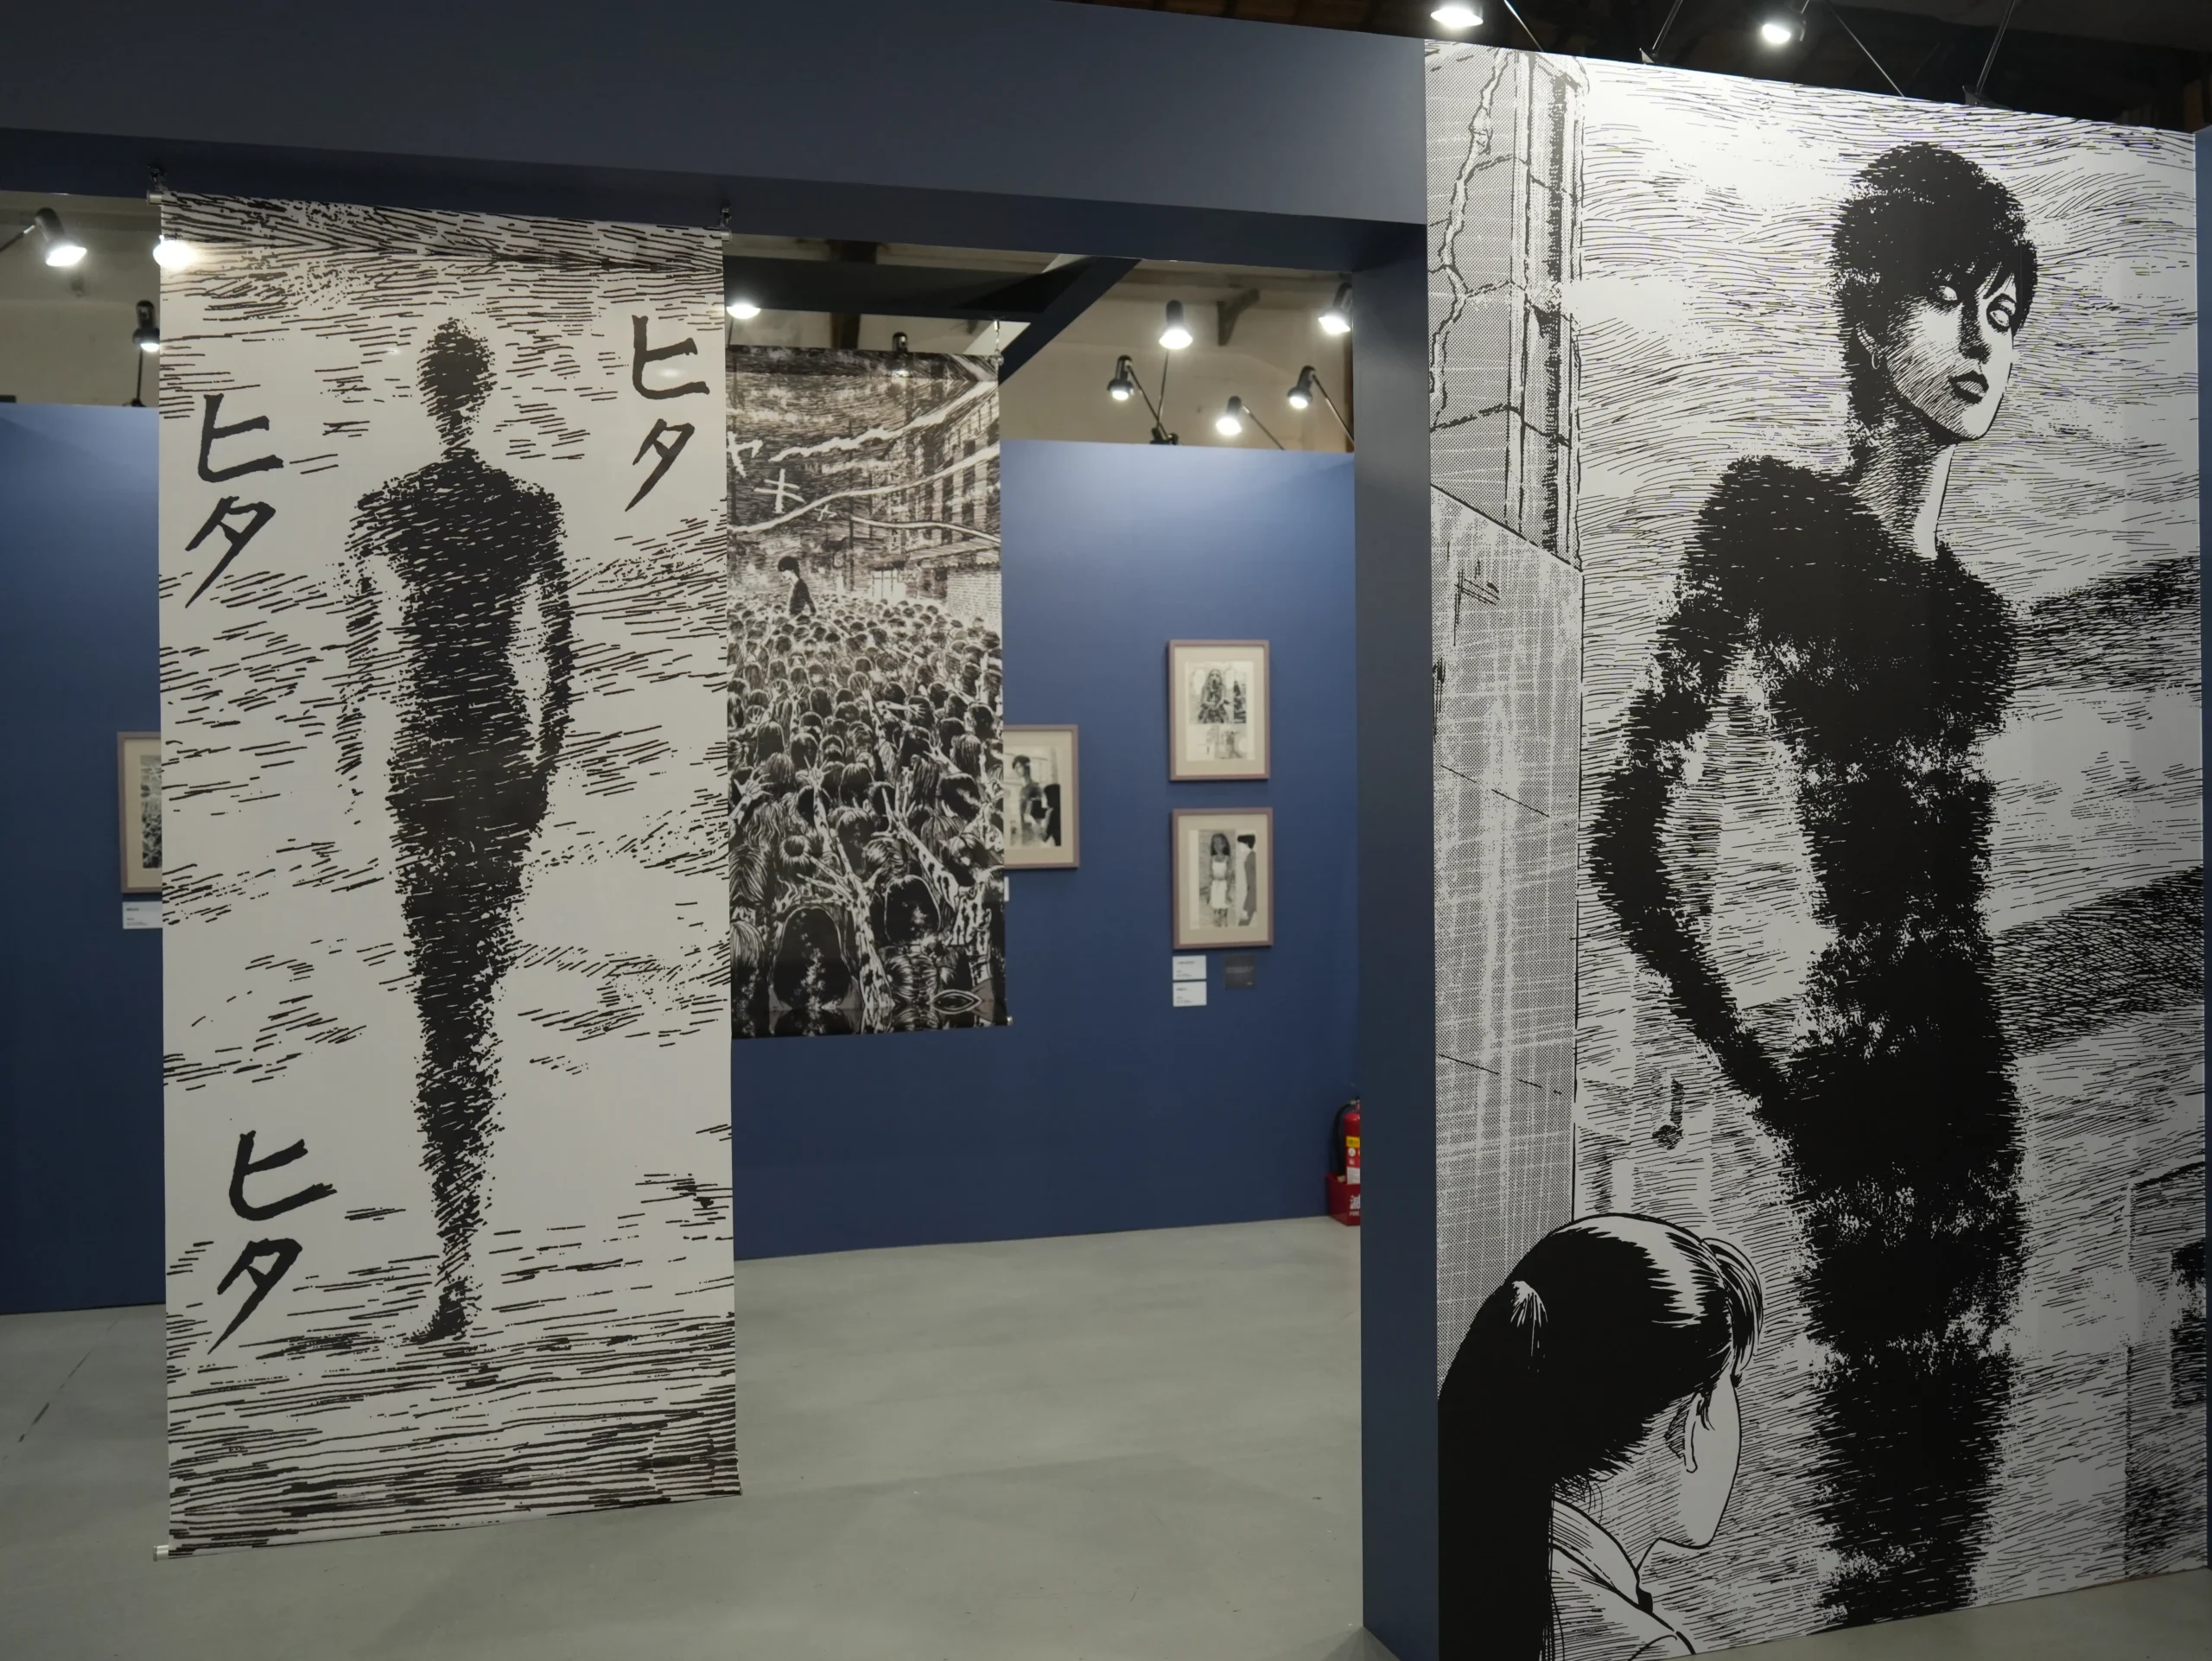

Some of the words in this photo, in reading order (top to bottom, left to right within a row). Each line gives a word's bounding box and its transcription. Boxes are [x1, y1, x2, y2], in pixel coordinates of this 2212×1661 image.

[185, 393, 283, 608] ヒタ
[626, 315, 709, 512] ヒタ
[207, 1130, 338, 1354] ヒタ
